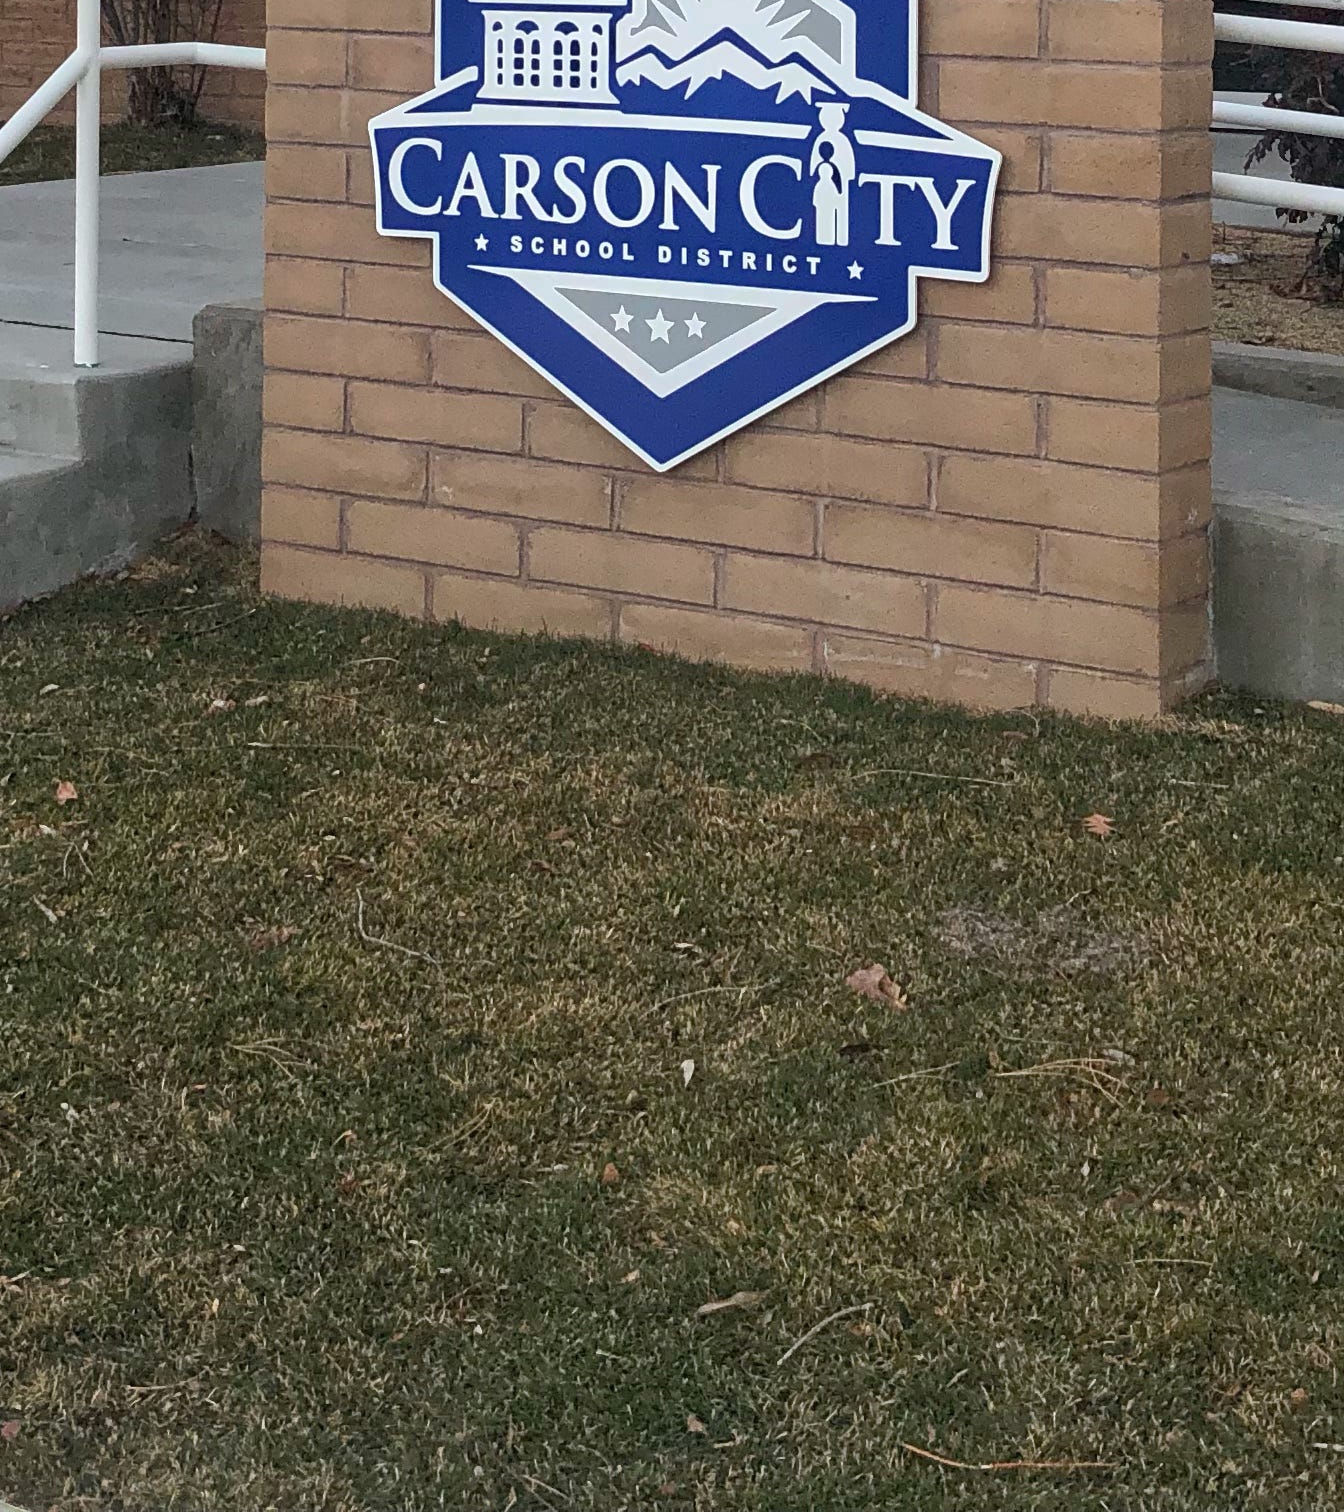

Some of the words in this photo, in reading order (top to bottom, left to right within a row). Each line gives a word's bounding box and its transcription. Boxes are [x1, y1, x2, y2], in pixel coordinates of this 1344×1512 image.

[387, 137, 721, 233] CARSON
[509, 234, 635, 261] SCHOOL
[657, 245, 822, 276] DISTRICT
